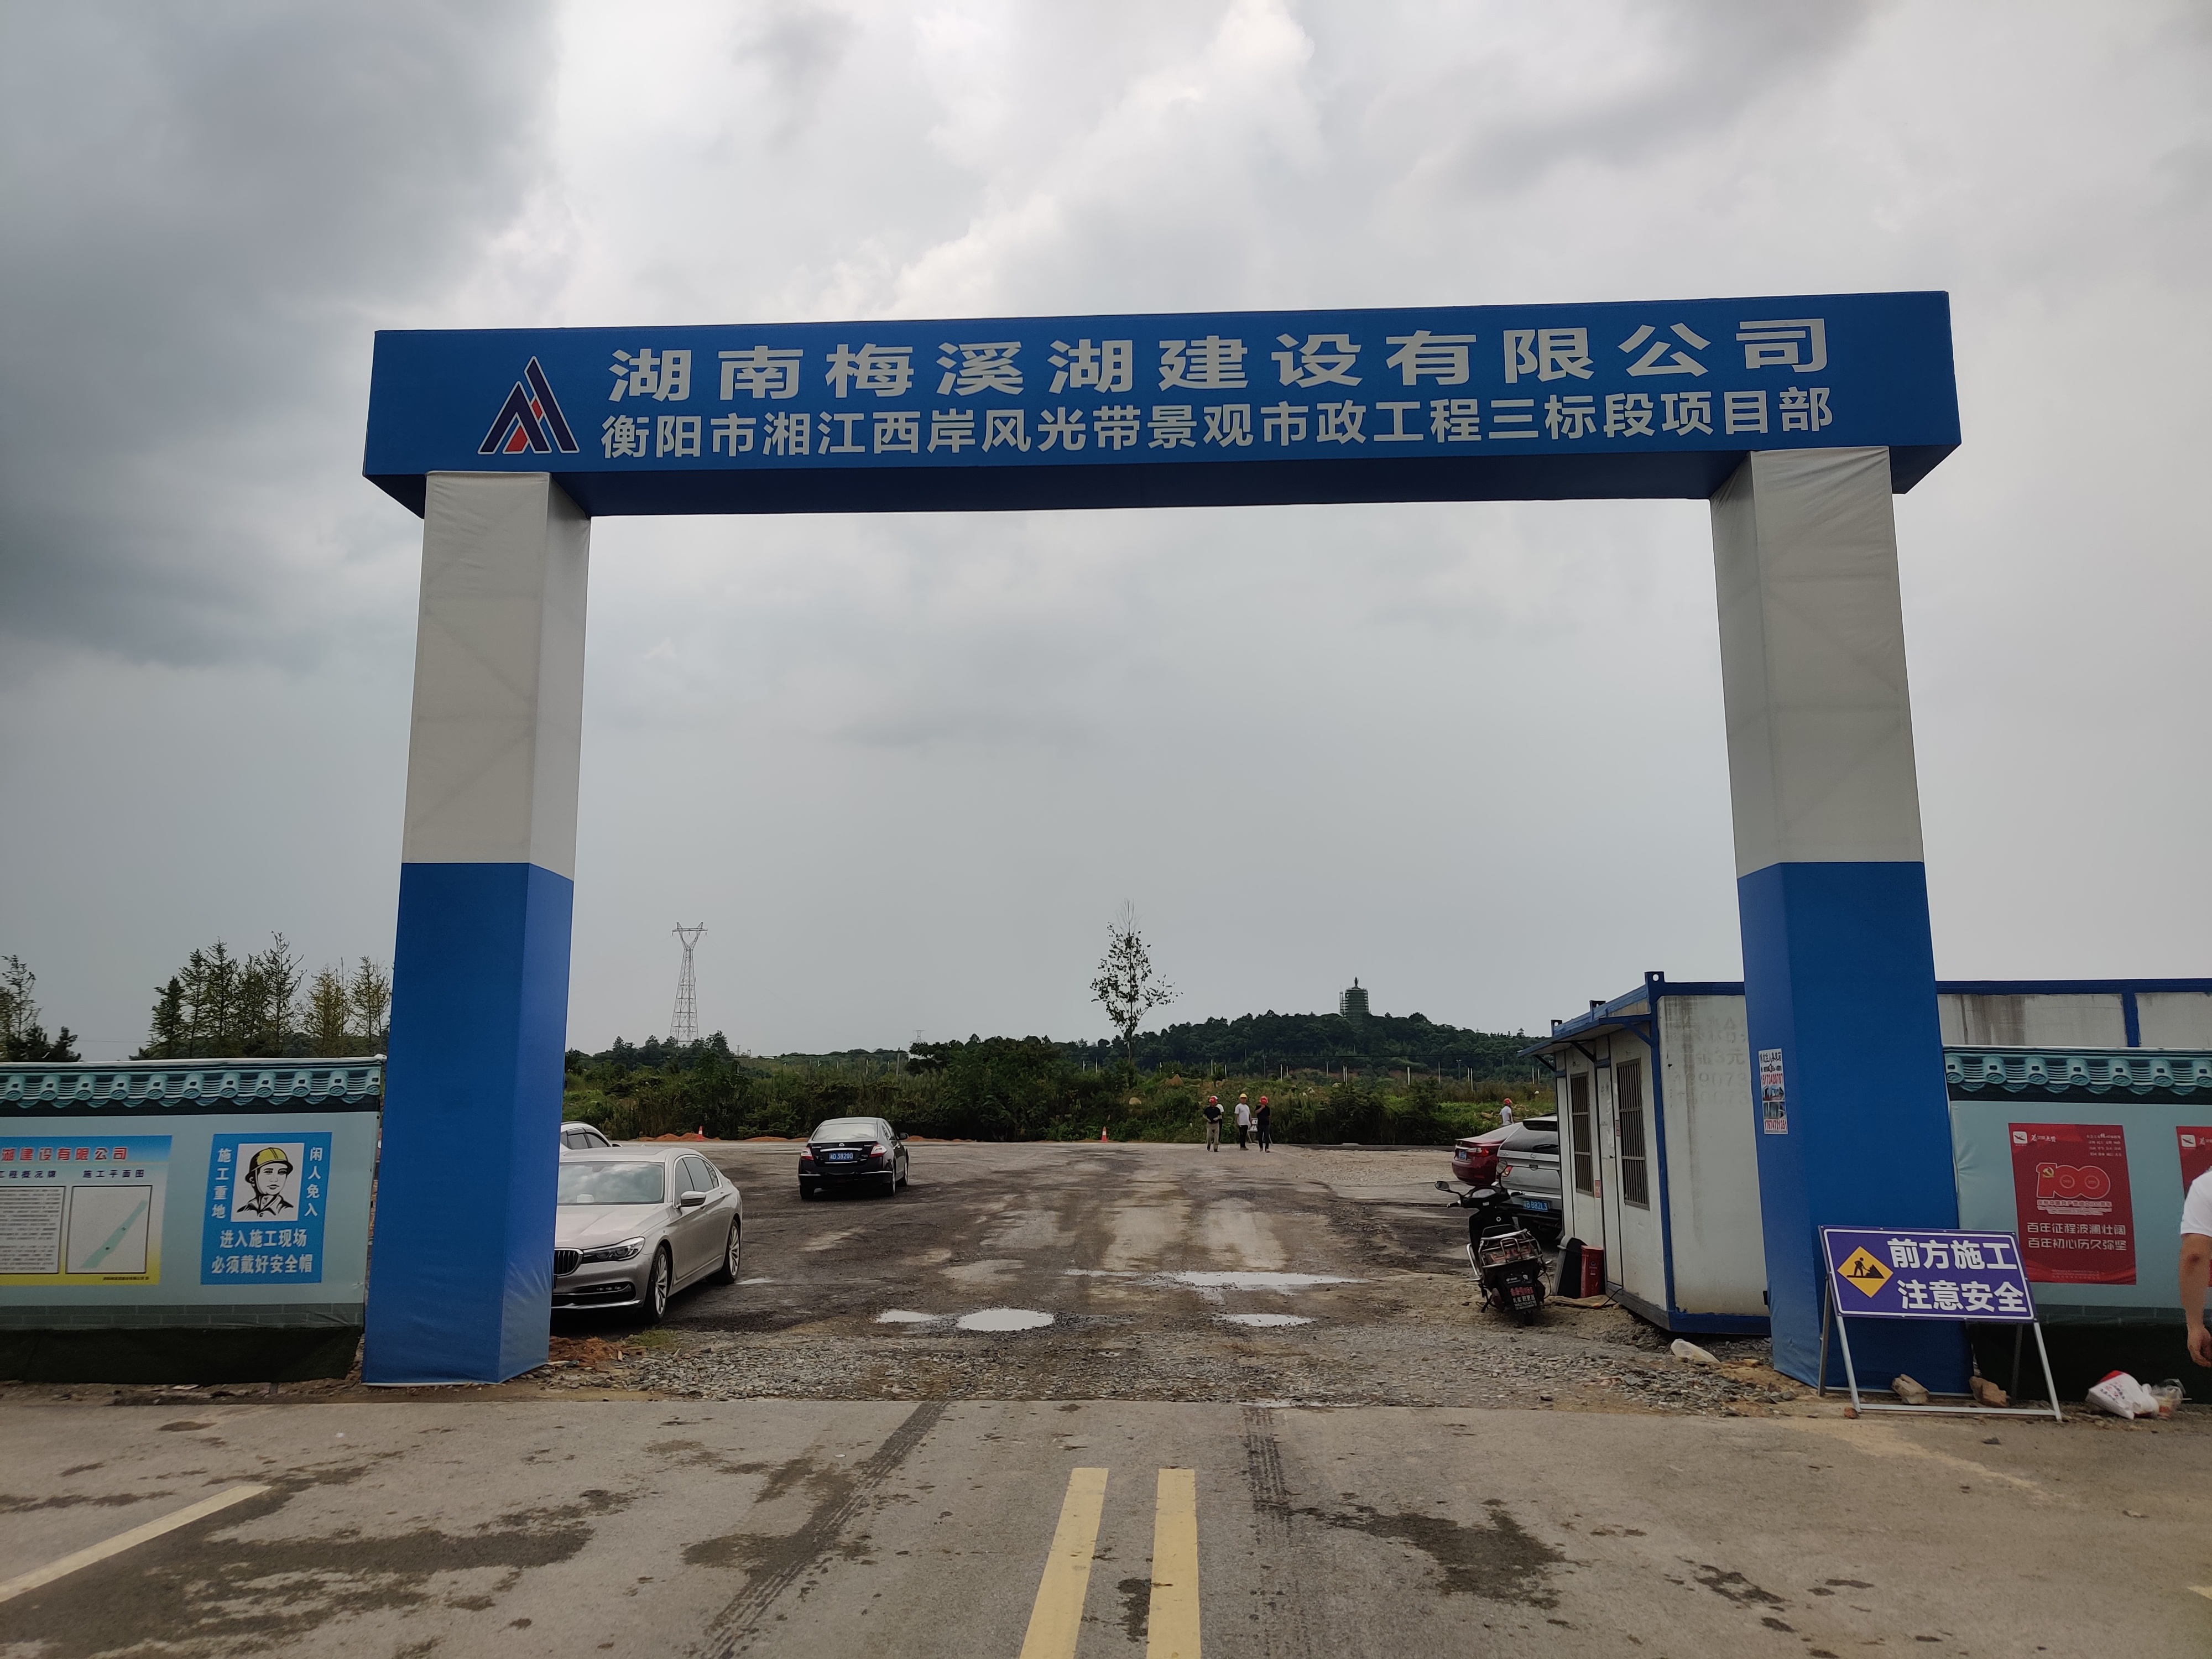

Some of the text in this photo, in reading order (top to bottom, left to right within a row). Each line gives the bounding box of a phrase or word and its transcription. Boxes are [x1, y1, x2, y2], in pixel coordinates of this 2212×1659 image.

[607, 317, 1827, 402] 湖南梅溪湖建设有限公司
[601, 386, 1833, 459] 衡阳市湘江西岸风光带景观市政工程三标段项目部
[83, 1170, 145, 1178] 施工平面图
[211, 1147, 232, 1219] 施工重地
[304, 1147, 324, 1217] 闲人免入
[2036, 1162, 2111, 1199] 100
[220, 1228, 307, 1249] 进入施工现场
[2027, 1222, 2126, 1235] 百年征程波澜壮阔
[2028, 1237, 2127, 1251] 百年初心历久弥坚
[211, 1254, 314, 1275] 必须戴好安全帽
[1887, 1238, 2017, 1270] 前方施工
[1897, 1279, 2027, 1312] 注意安全
